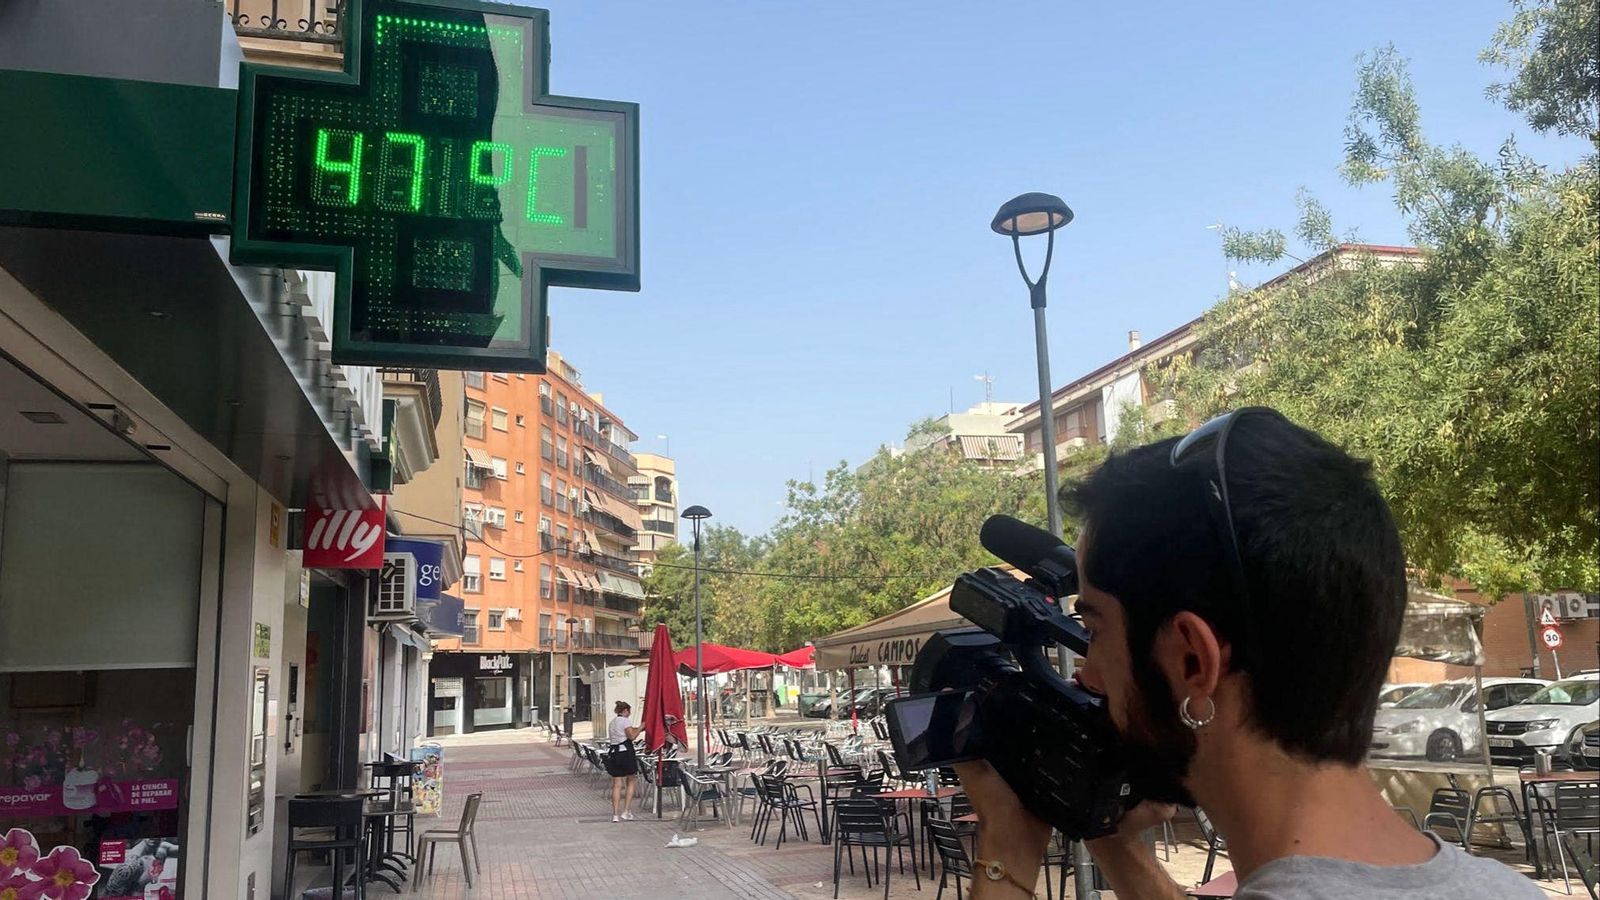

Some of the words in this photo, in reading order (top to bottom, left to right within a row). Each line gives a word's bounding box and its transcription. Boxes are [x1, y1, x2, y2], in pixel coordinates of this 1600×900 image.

[308, 509, 381, 562] illy
[1545, 634, 1558, 642] 30
[141, 783, 168, 791] CIENCIA
